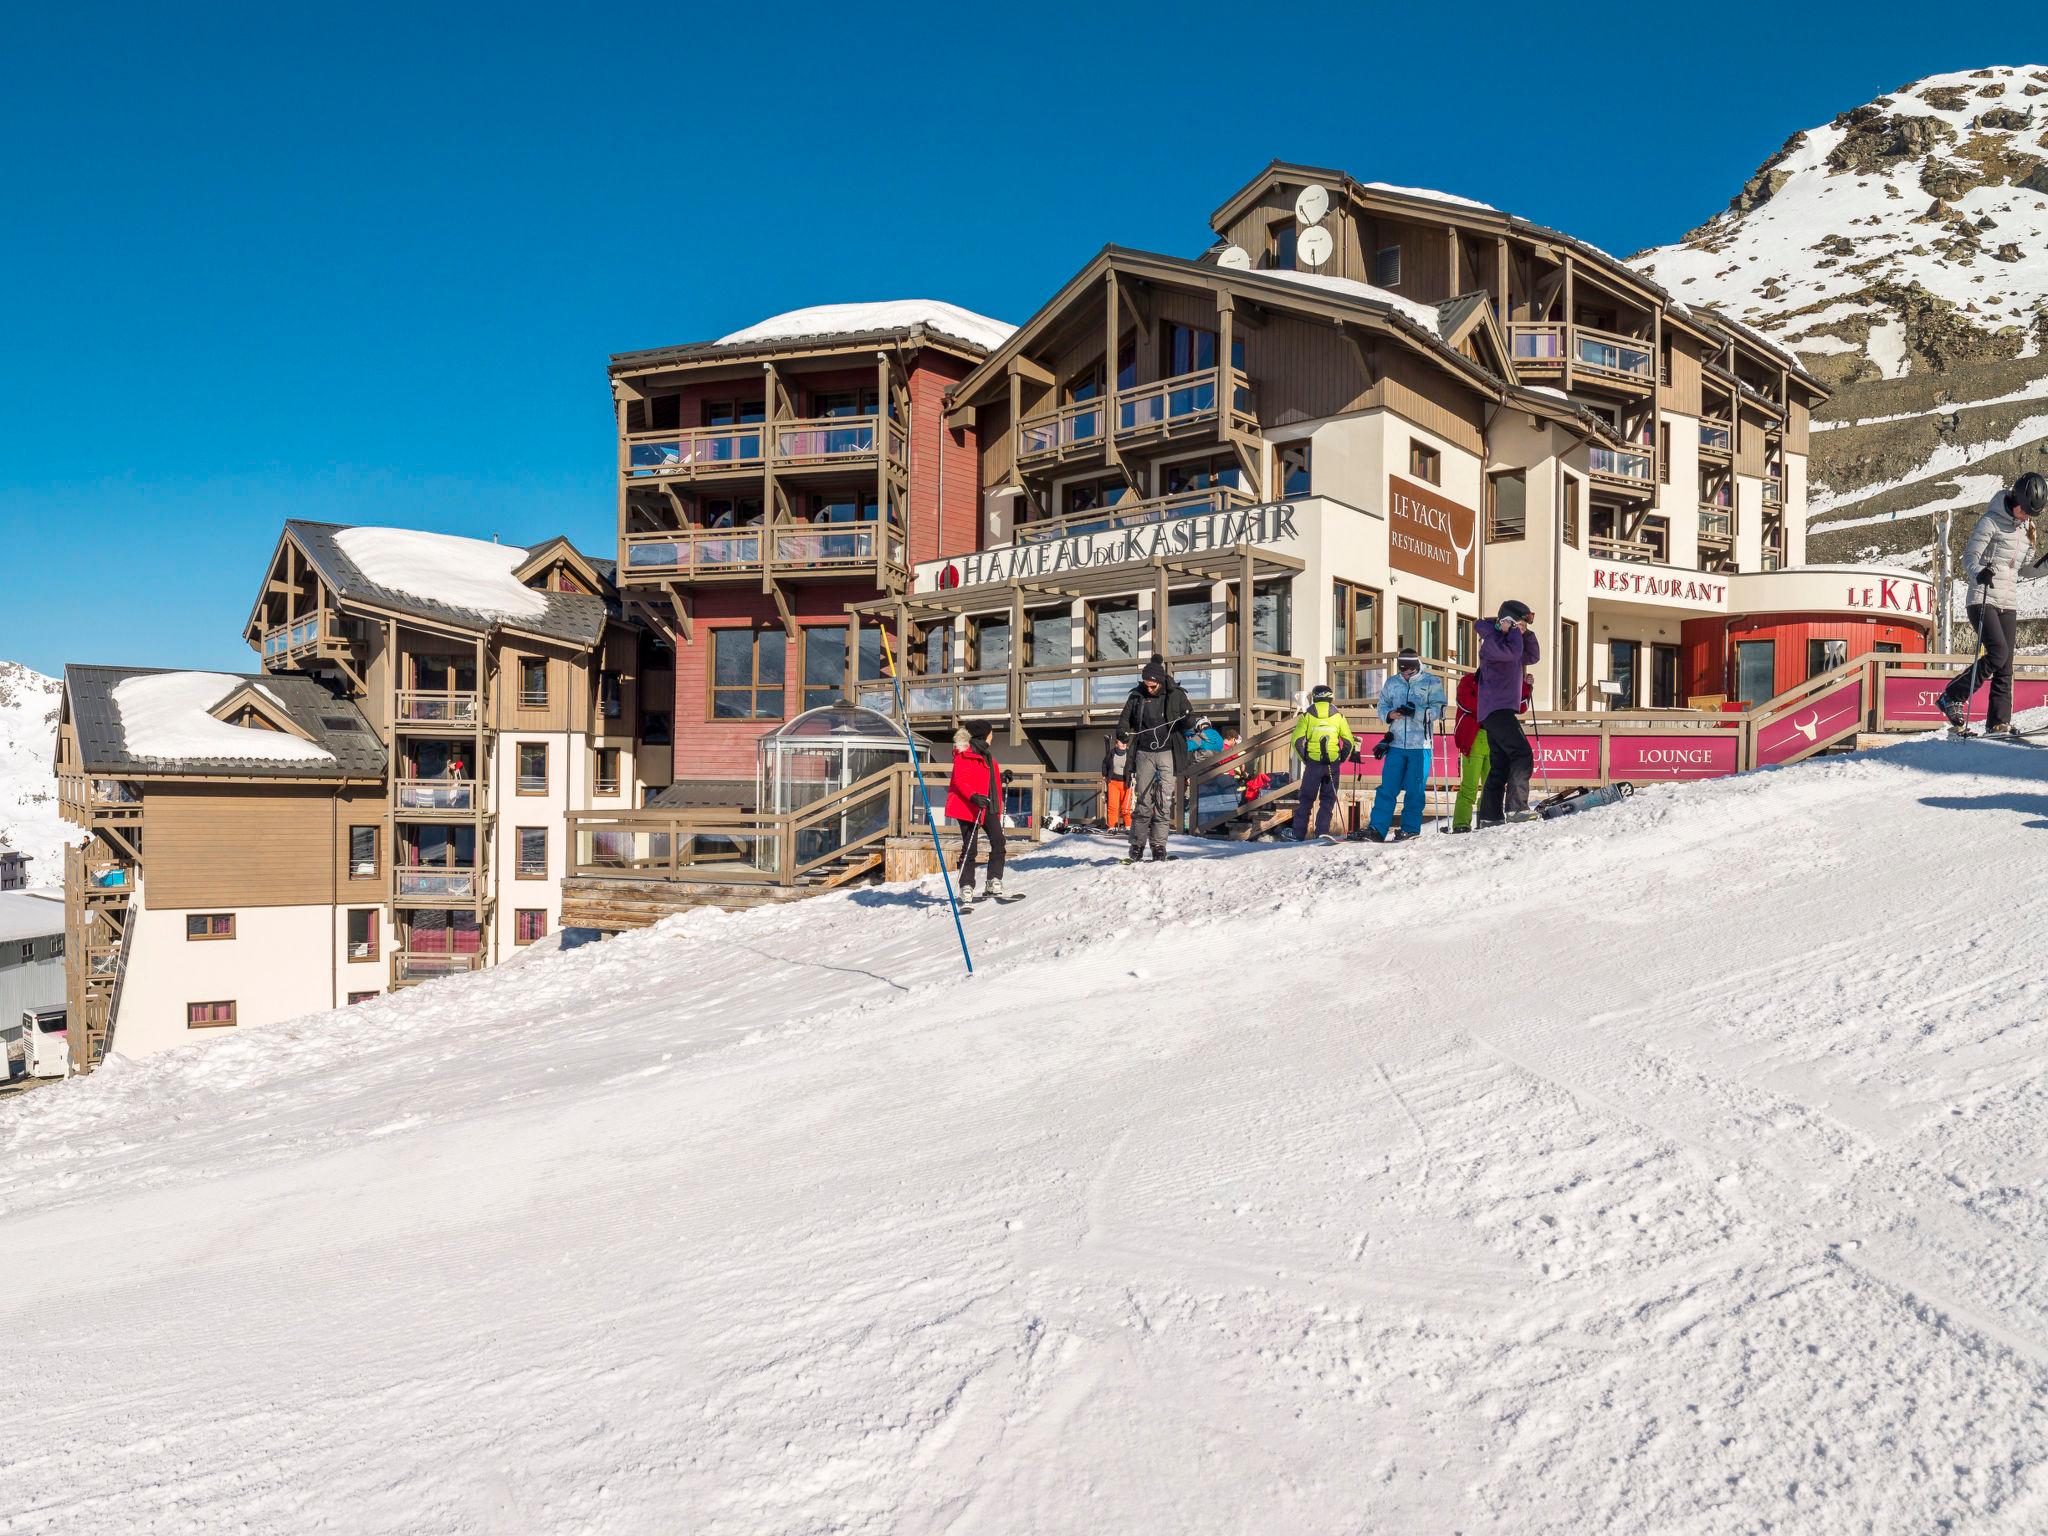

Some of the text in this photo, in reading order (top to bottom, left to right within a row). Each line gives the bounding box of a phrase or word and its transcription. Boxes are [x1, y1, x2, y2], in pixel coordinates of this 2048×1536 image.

[1393, 493, 1448, 533] LE YACK
[962, 505, 1300, 586] HAMEAU DU KASHMIR
[1391, 531, 1452, 565] RESTAURANT
[1593, 569, 1726, 604] RESTAURANT
[1846, 587, 1874, 608] LE
[1638, 749, 1713, 764] LOUNGE
